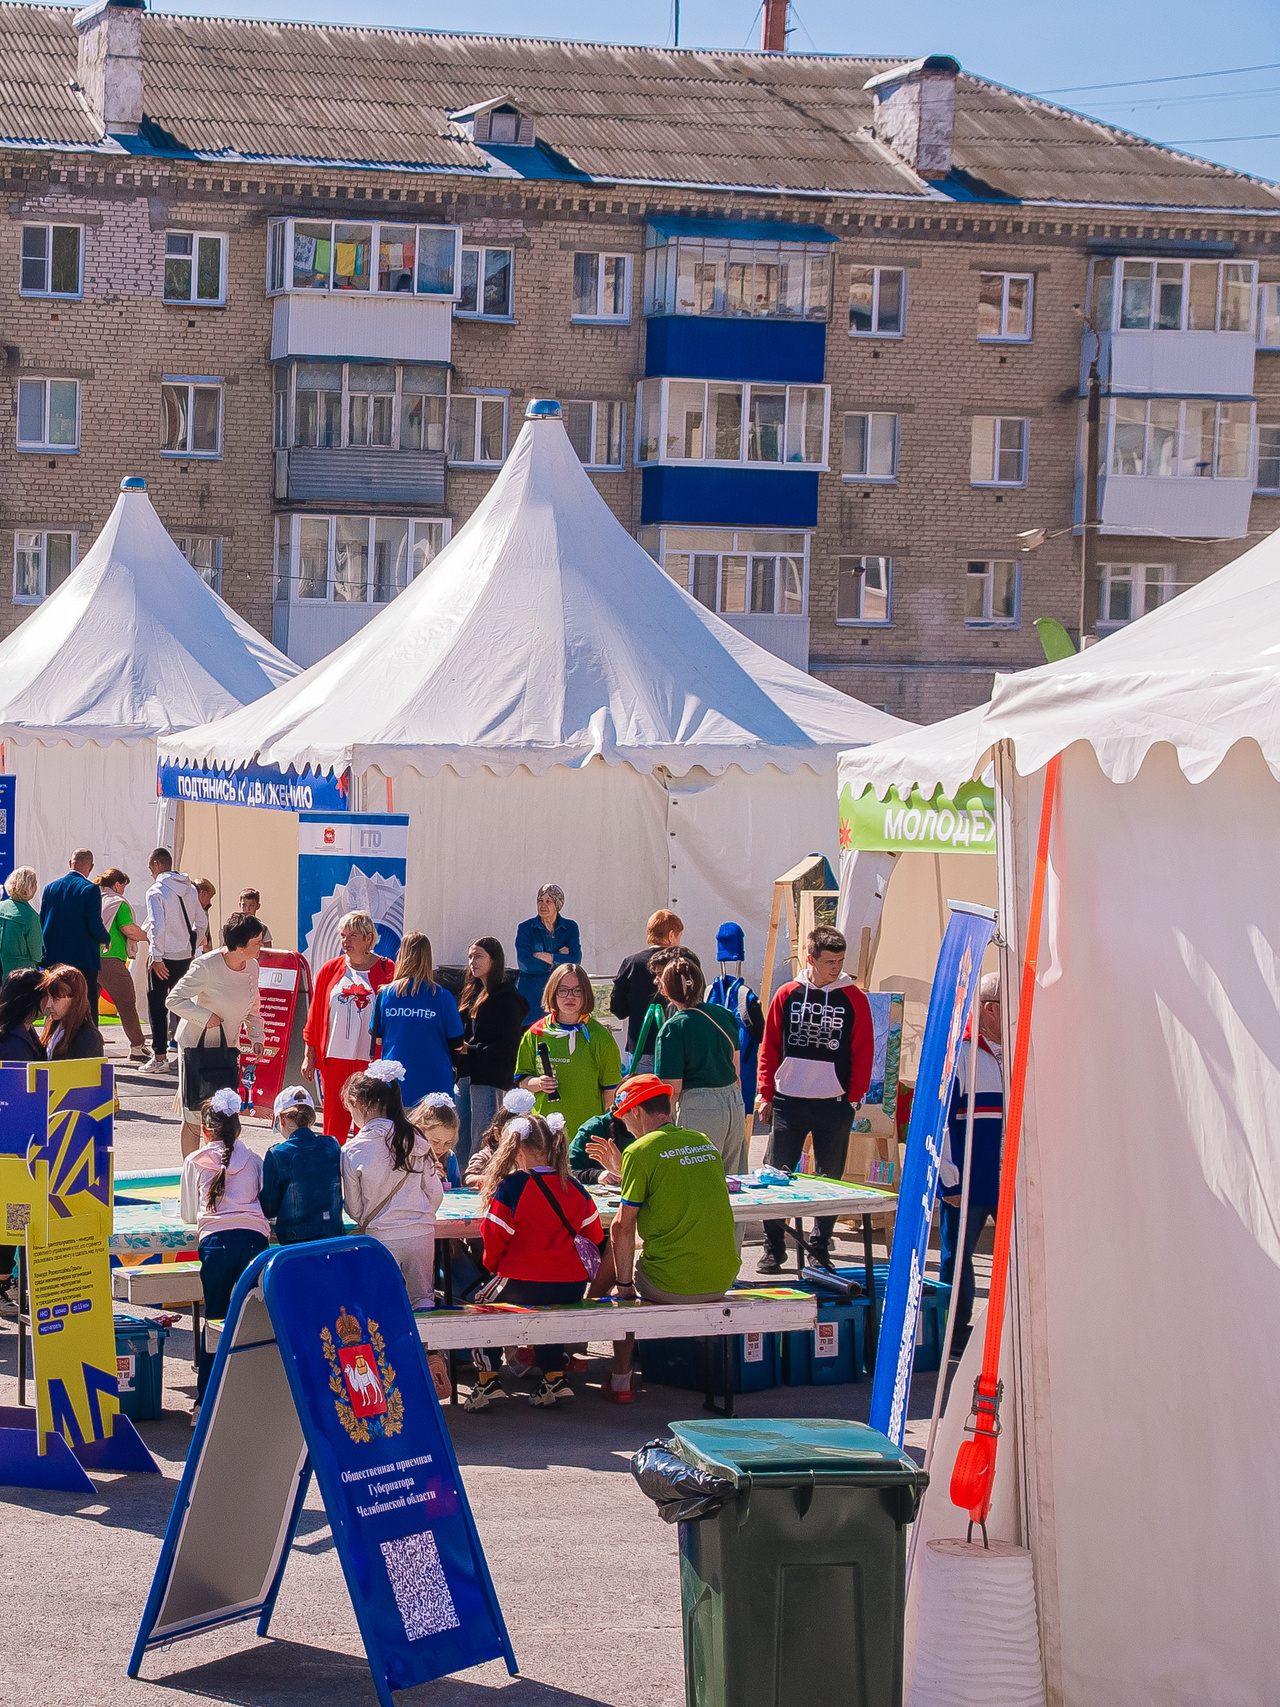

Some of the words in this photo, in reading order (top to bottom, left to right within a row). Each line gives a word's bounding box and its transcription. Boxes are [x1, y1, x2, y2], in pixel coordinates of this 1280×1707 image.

[178, 775, 236, 802] ПОДТЯНИСЬ
[238, 781, 246, 802] К
[247, 782, 313, 809] ДВИЖЕНИЮ
[385, 1007, 436, 1019] ВОЛОНТЁР
[680, 1154, 716, 1166] область
[341, 1463, 395, 1483] Общественная
[396, 1454, 433, 1472] приемная
[368, 1477, 415, 1497] Губернатора
[357, 1496, 406, 1517] Челябинской
[407, 1490, 436, 1505] области
